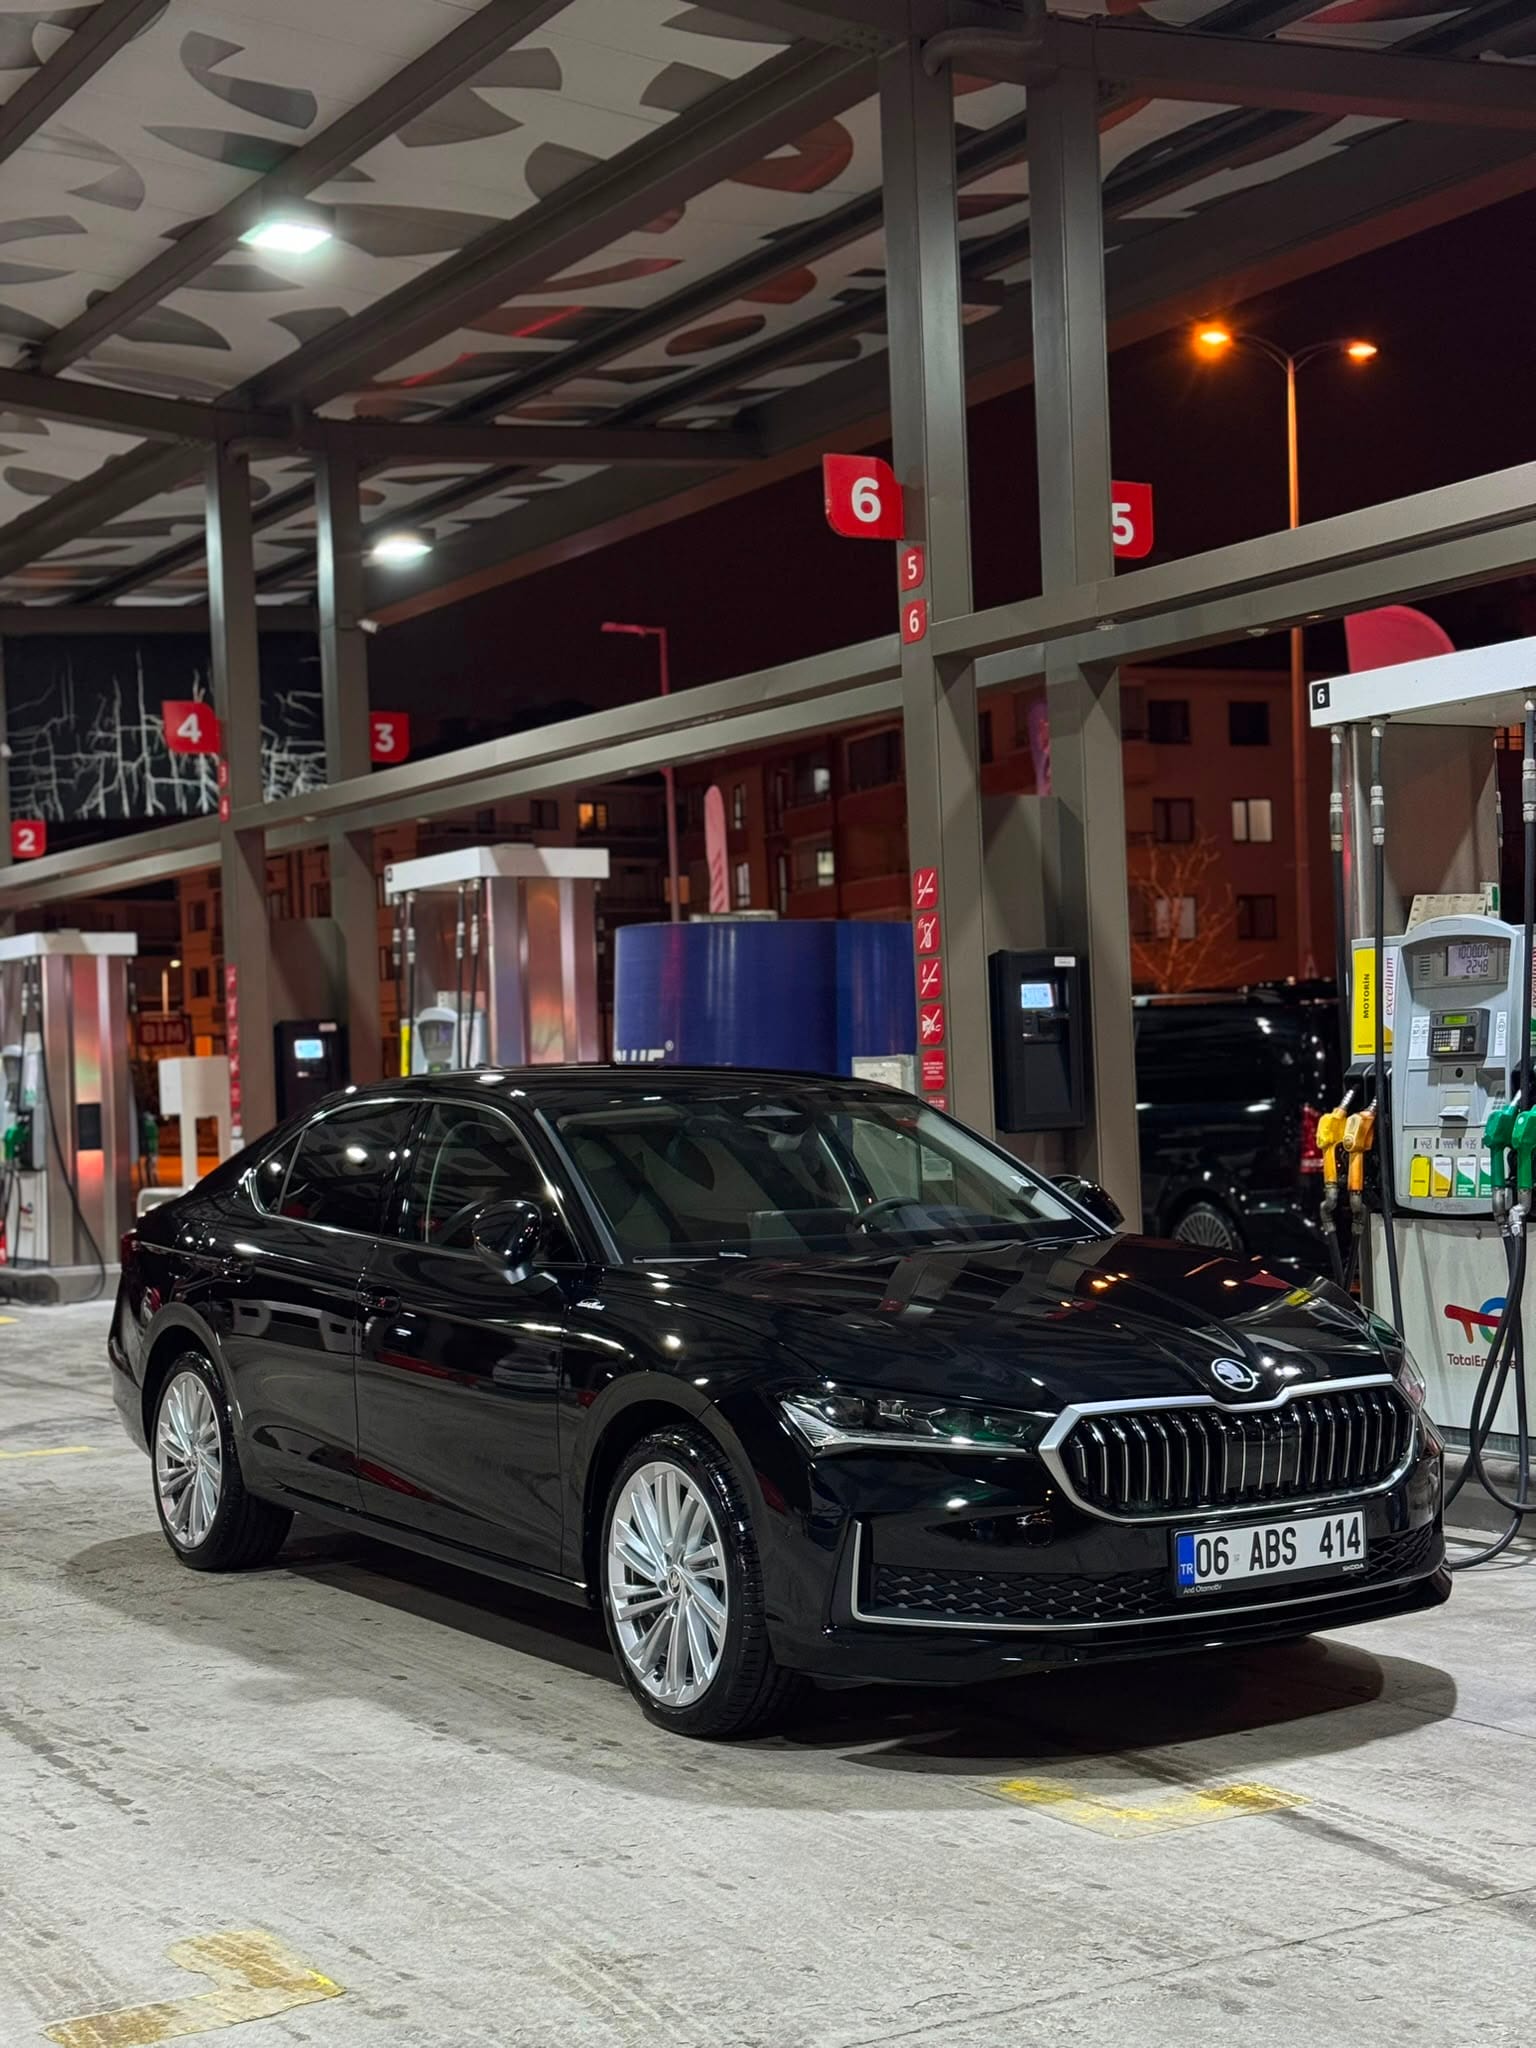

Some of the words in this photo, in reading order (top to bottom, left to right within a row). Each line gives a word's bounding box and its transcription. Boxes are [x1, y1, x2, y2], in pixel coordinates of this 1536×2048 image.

[851, 477, 881, 522] 6
[1112, 503, 1134, 545] 5
[907, 556, 918, 580] 5
[909, 609, 919, 633] 6
[1317, 688, 1326, 705] 6
[177, 713, 201, 743] 4
[374, 723, 394, 752] 3
[17, 828, 36, 852] 2
[1385, 957, 1394, 1016] excellium
[1196, 1536, 1229, 1577] 06
[1249, 1527, 1297, 1571] ABS
[1319, 1516, 1361, 1559] 414
[1180, 1563, 1194, 1576] TR
